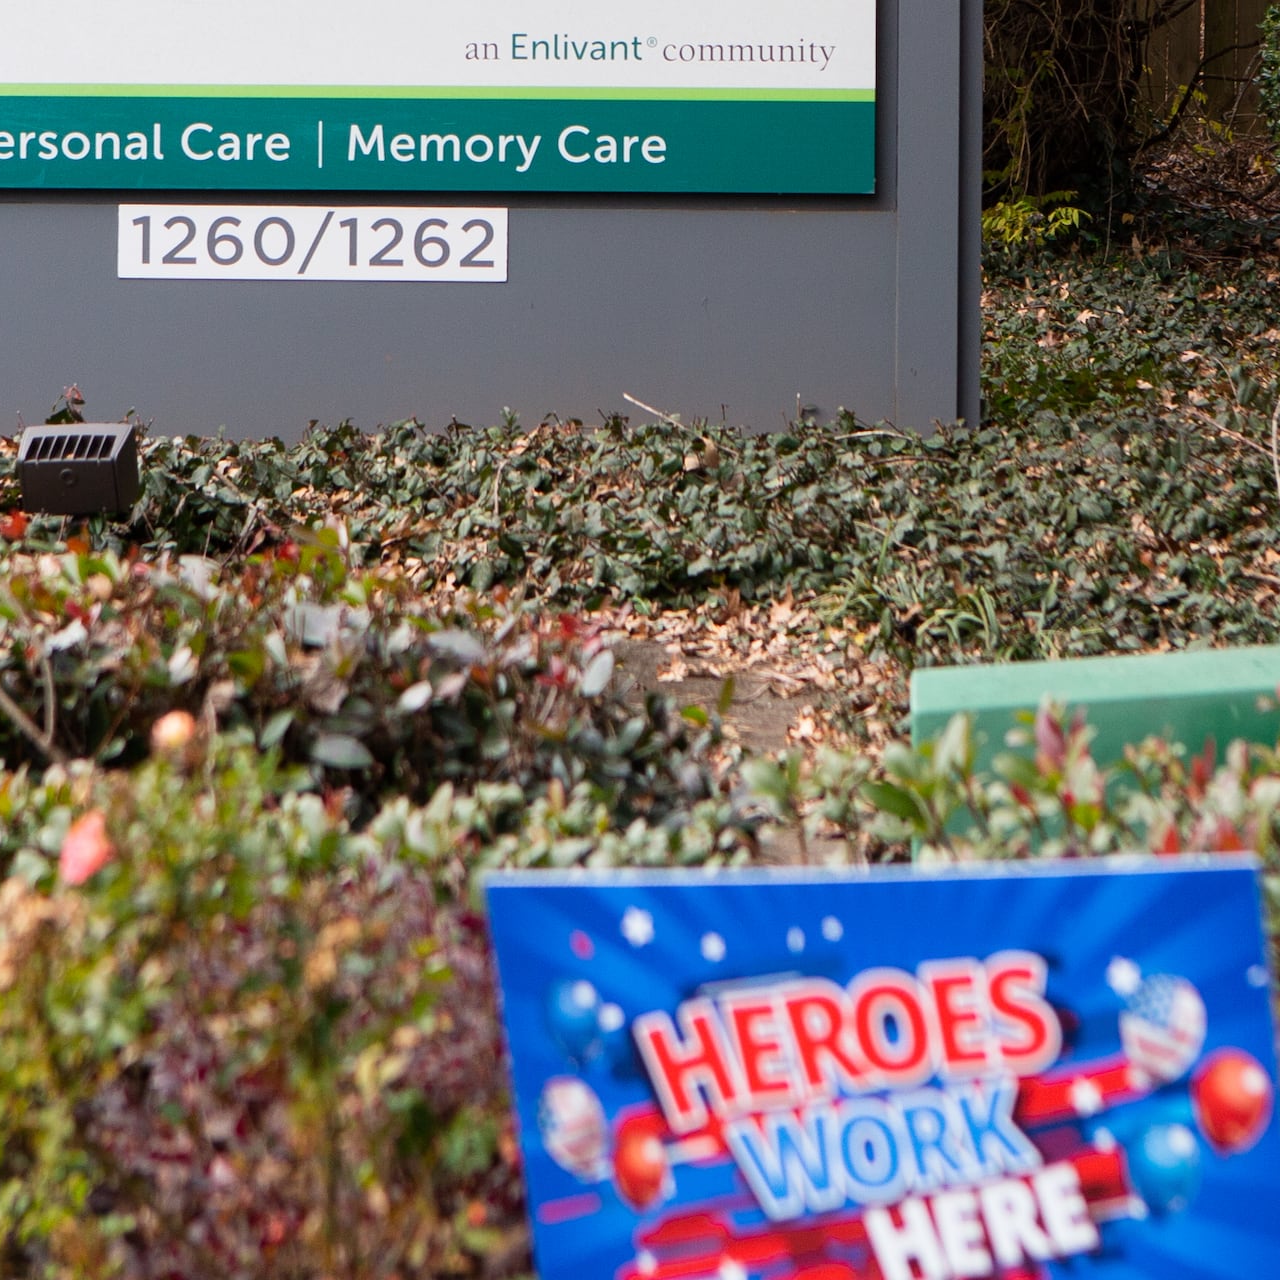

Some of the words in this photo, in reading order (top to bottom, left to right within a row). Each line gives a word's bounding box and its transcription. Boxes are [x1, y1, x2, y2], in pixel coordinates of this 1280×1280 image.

[464, 41, 500, 61] an
[662, 37, 837, 72] community
[179, 124, 292, 163] Care
[346, 124, 542, 173] Memory
[555, 127, 668, 165] Care
[132, 211, 496, 276] 1260/1262
[638, 955, 1057, 1128] HEROES
[728, 1078, 1042, 1217] WORK
[862, 1160, 1101, 1280] HERE
